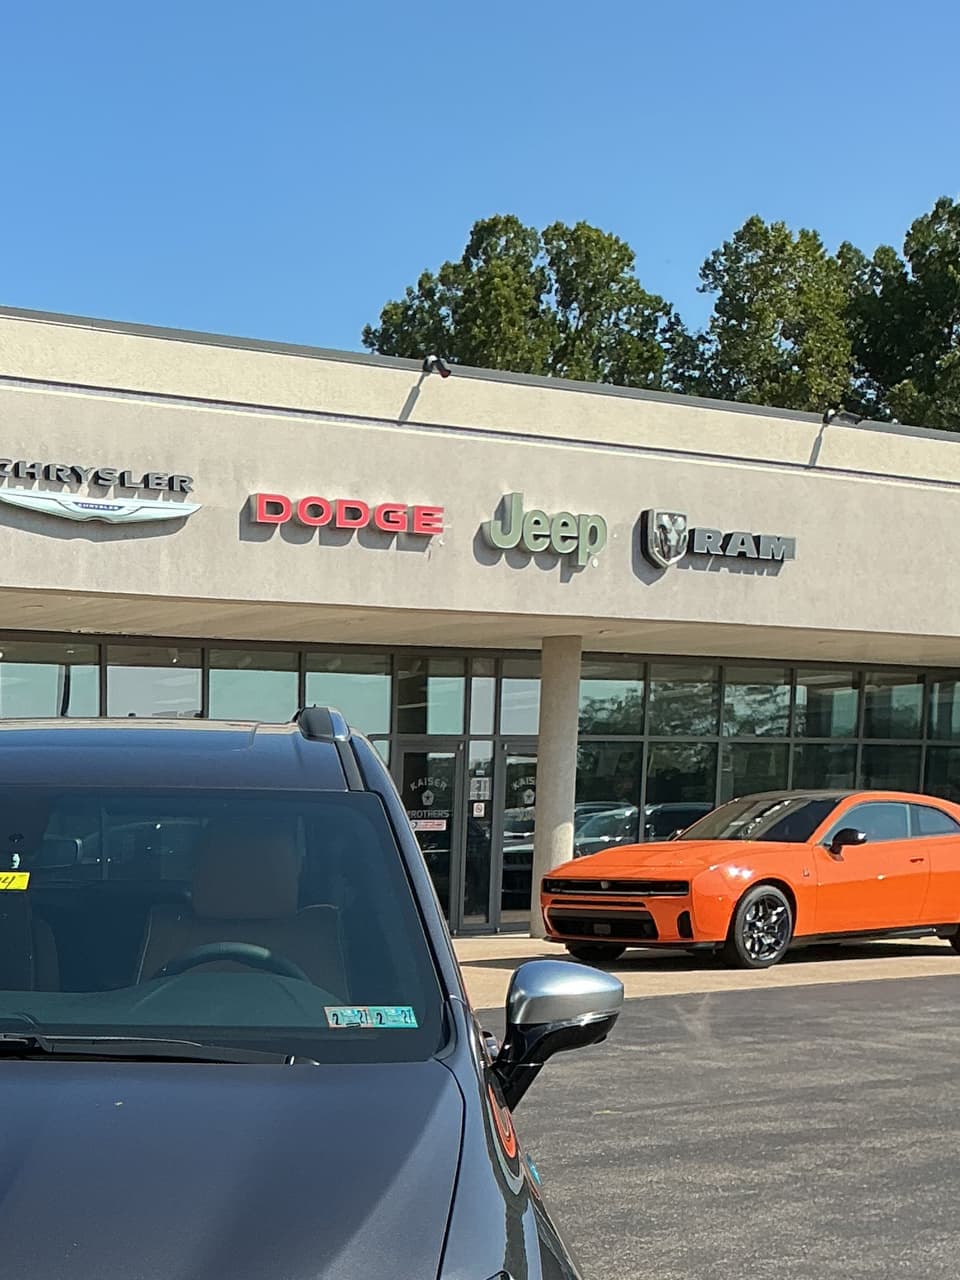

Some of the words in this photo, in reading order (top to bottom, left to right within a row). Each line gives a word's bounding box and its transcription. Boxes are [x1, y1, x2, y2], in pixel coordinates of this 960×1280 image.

[255, 492, 444, 535] DODGE
[490, 492, 607, 566] Jeep
[692, 527, 796, 561] RAM
[410, 776, 448, 791] KAISER
[512, 776, 536, 791] KAIS
